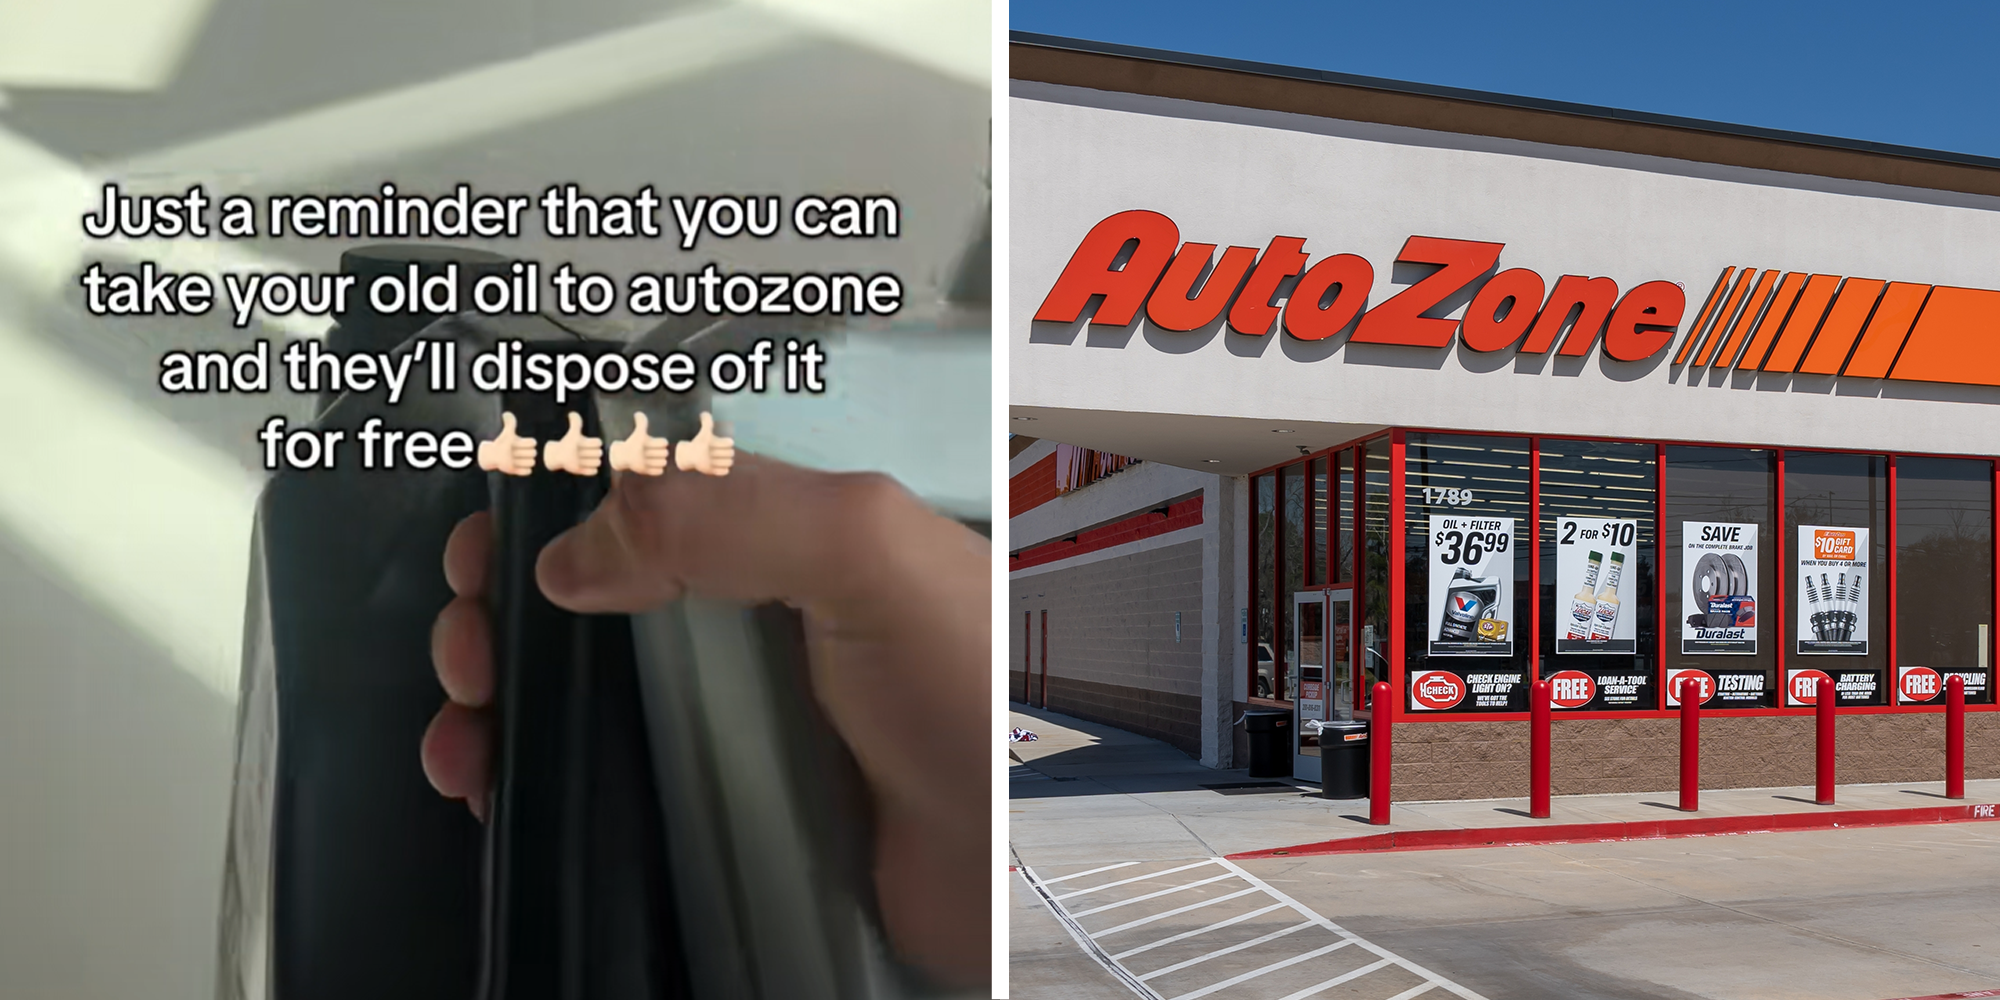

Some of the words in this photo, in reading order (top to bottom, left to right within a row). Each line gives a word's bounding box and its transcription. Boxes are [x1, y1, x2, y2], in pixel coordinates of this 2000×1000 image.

[1031, 209, 1686, 363] AutoZone
[1422, 488, 1473, 505] 1789
[1443, 519, 1458, 530] OIL
[1470, 521, 1501, 531] FILTER
[1560, 521, 1577, 545] 2
[1580, 530, 1598, 539] FOR
[1601, 522, 1635, 546] $10
[1701, 525, 1741, 542] SAVE
[1815, 536, 1834, 553] $10
[1835, 538, 1851, 546] GIFT
[1834, 546, 1853, 554] CARD
[1695, 628, 1745, 639] Duralast
[1467, 674, 1493, 684] CHECK
[1494, 674, 1521, 684] ENGINE
[1597, 675, 1647, 685] LOAN-A-TOOL
[1718, 674, 1764, 691] TESTING
[1841, 674, 1875, 682] BATTERY
[1472, 684, 1495, 693] LIGHT
[1495, 684, 1512, 693] ON?
[1552, 679, 1588, 700] FREE
[1604, 685, 1638, 694] SERVICE
[1836, 682, 1876, 691] CHARGING
[1906, 675, 1936, 694] FREE
[1426, 686, 1454, 695] CHECK
[1974, 805, 1995, 818] FIRE
